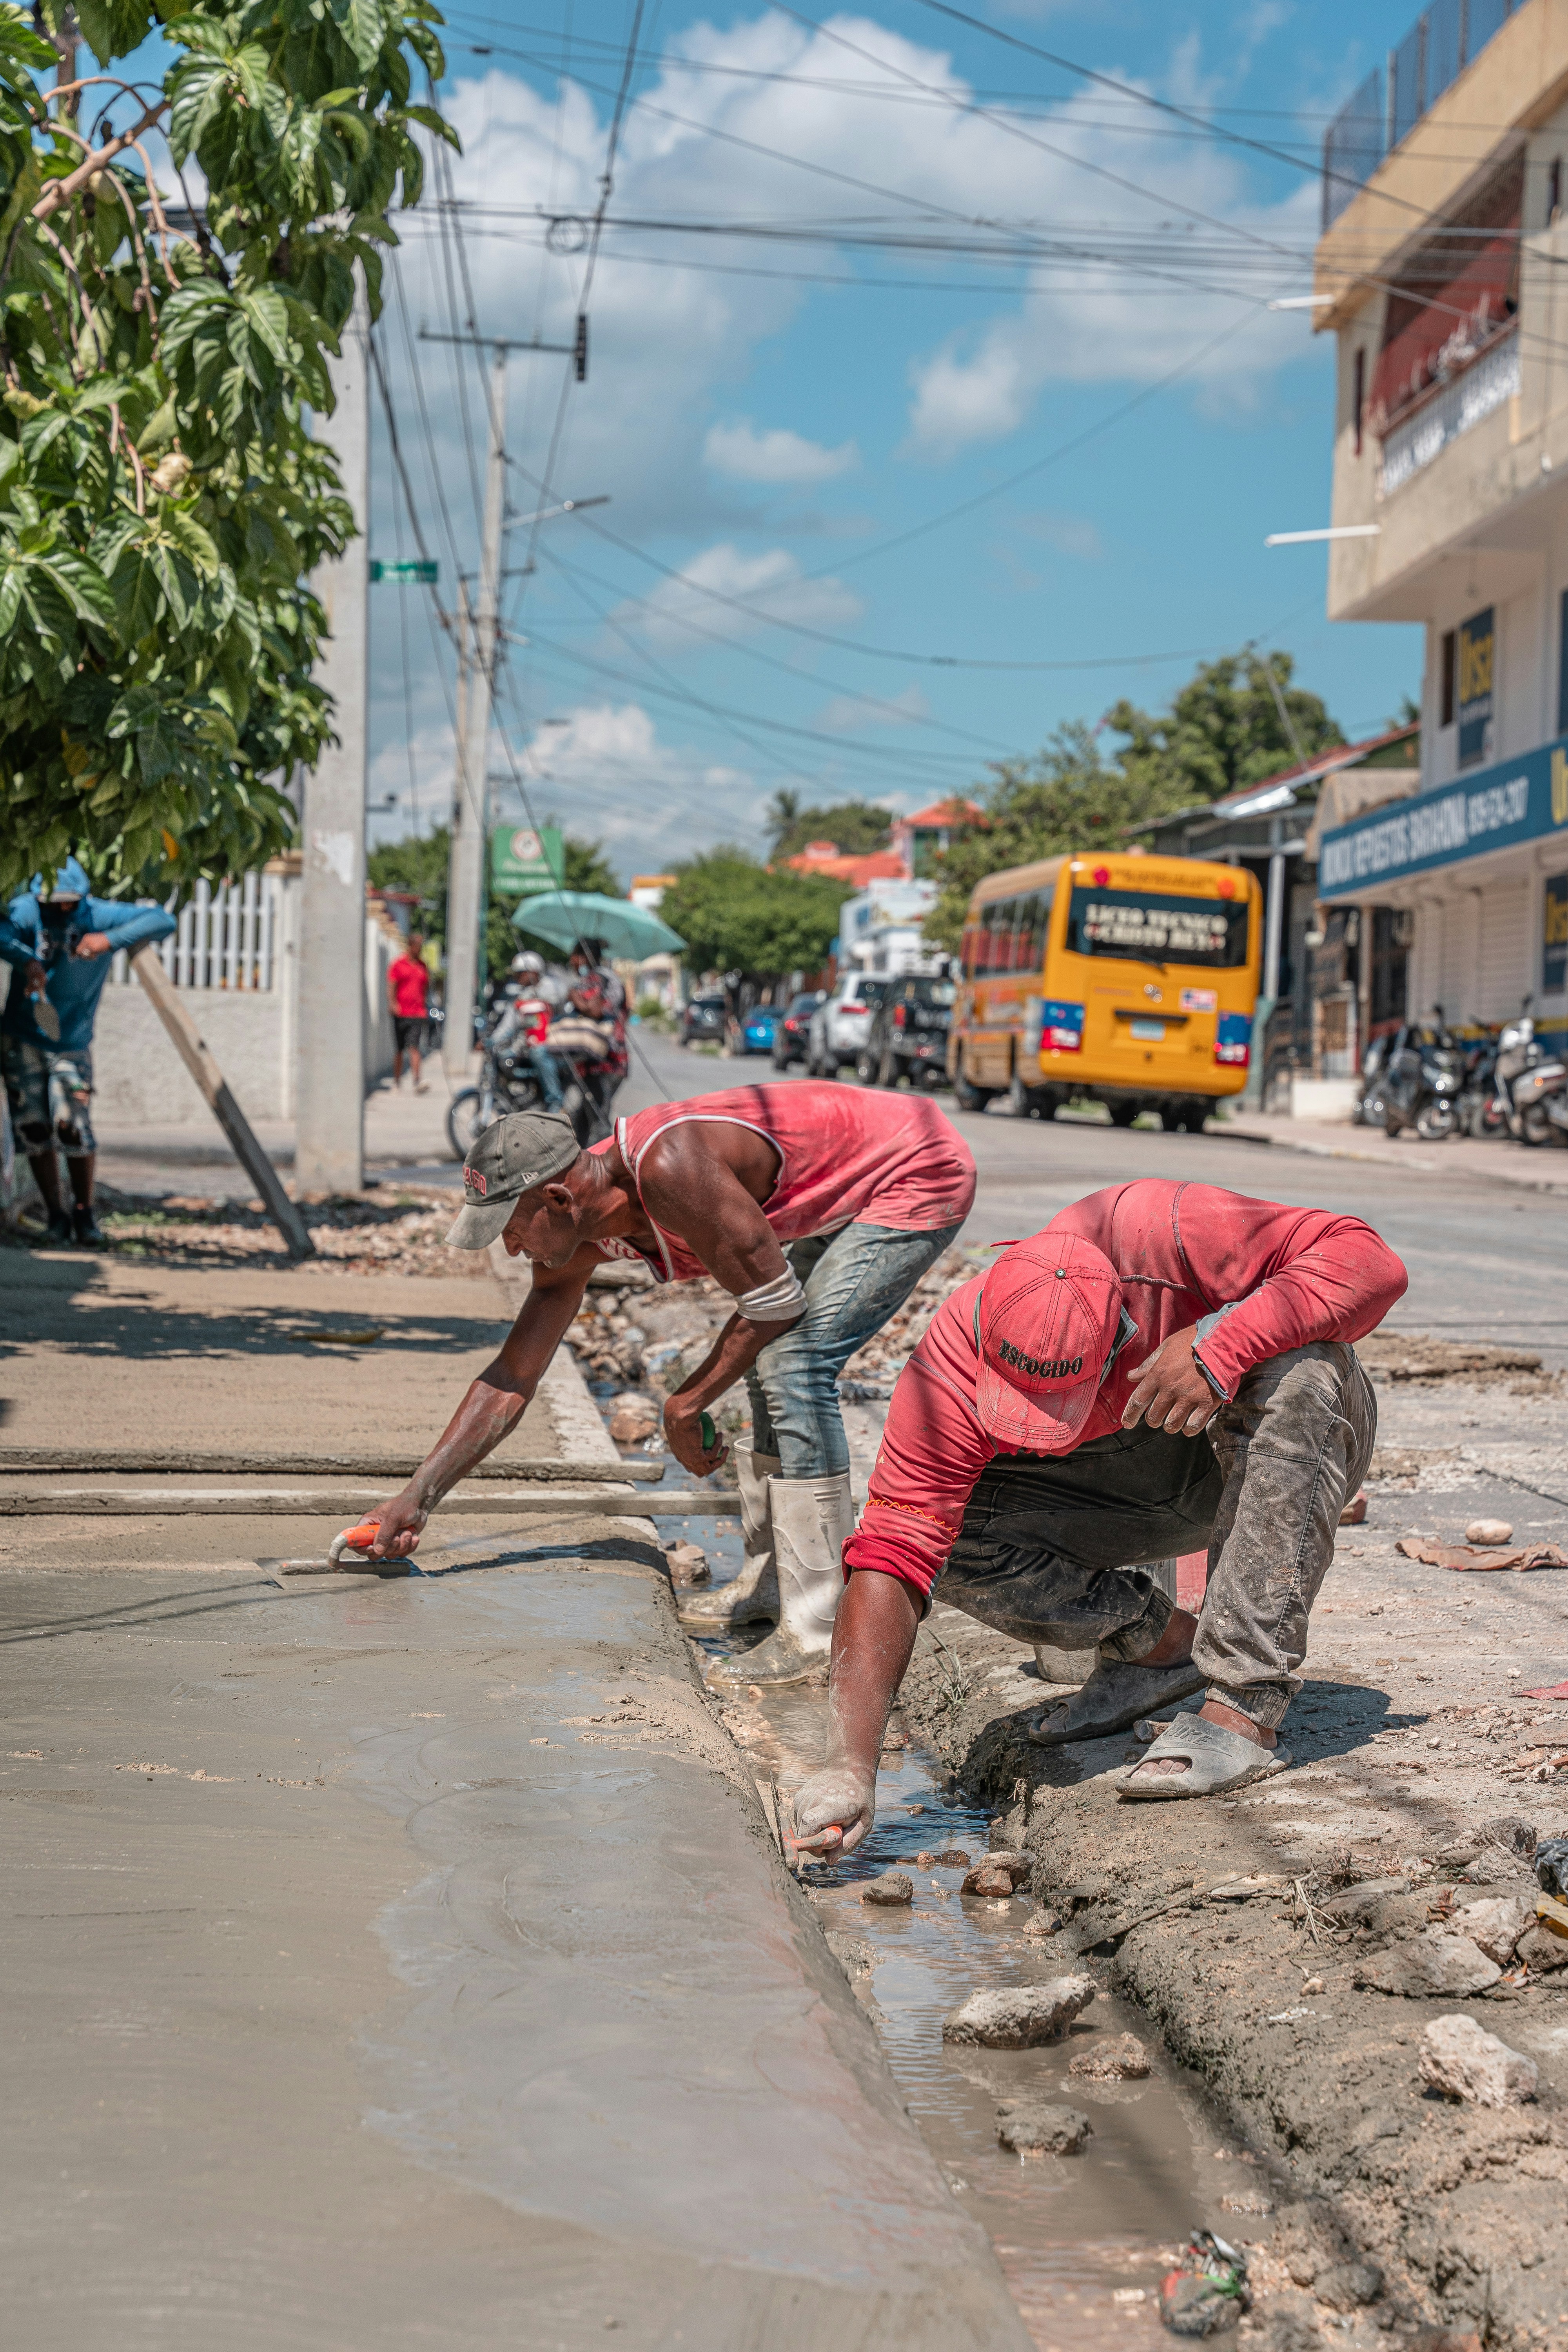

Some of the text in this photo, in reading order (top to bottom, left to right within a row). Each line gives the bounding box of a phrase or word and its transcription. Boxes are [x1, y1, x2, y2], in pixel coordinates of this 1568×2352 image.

[463, 1165, 486, 1196] AGO
[998, 1338, 1083, 1378] ESCOGIDO
[1163, 1726, 1212, 1745] NIKE
